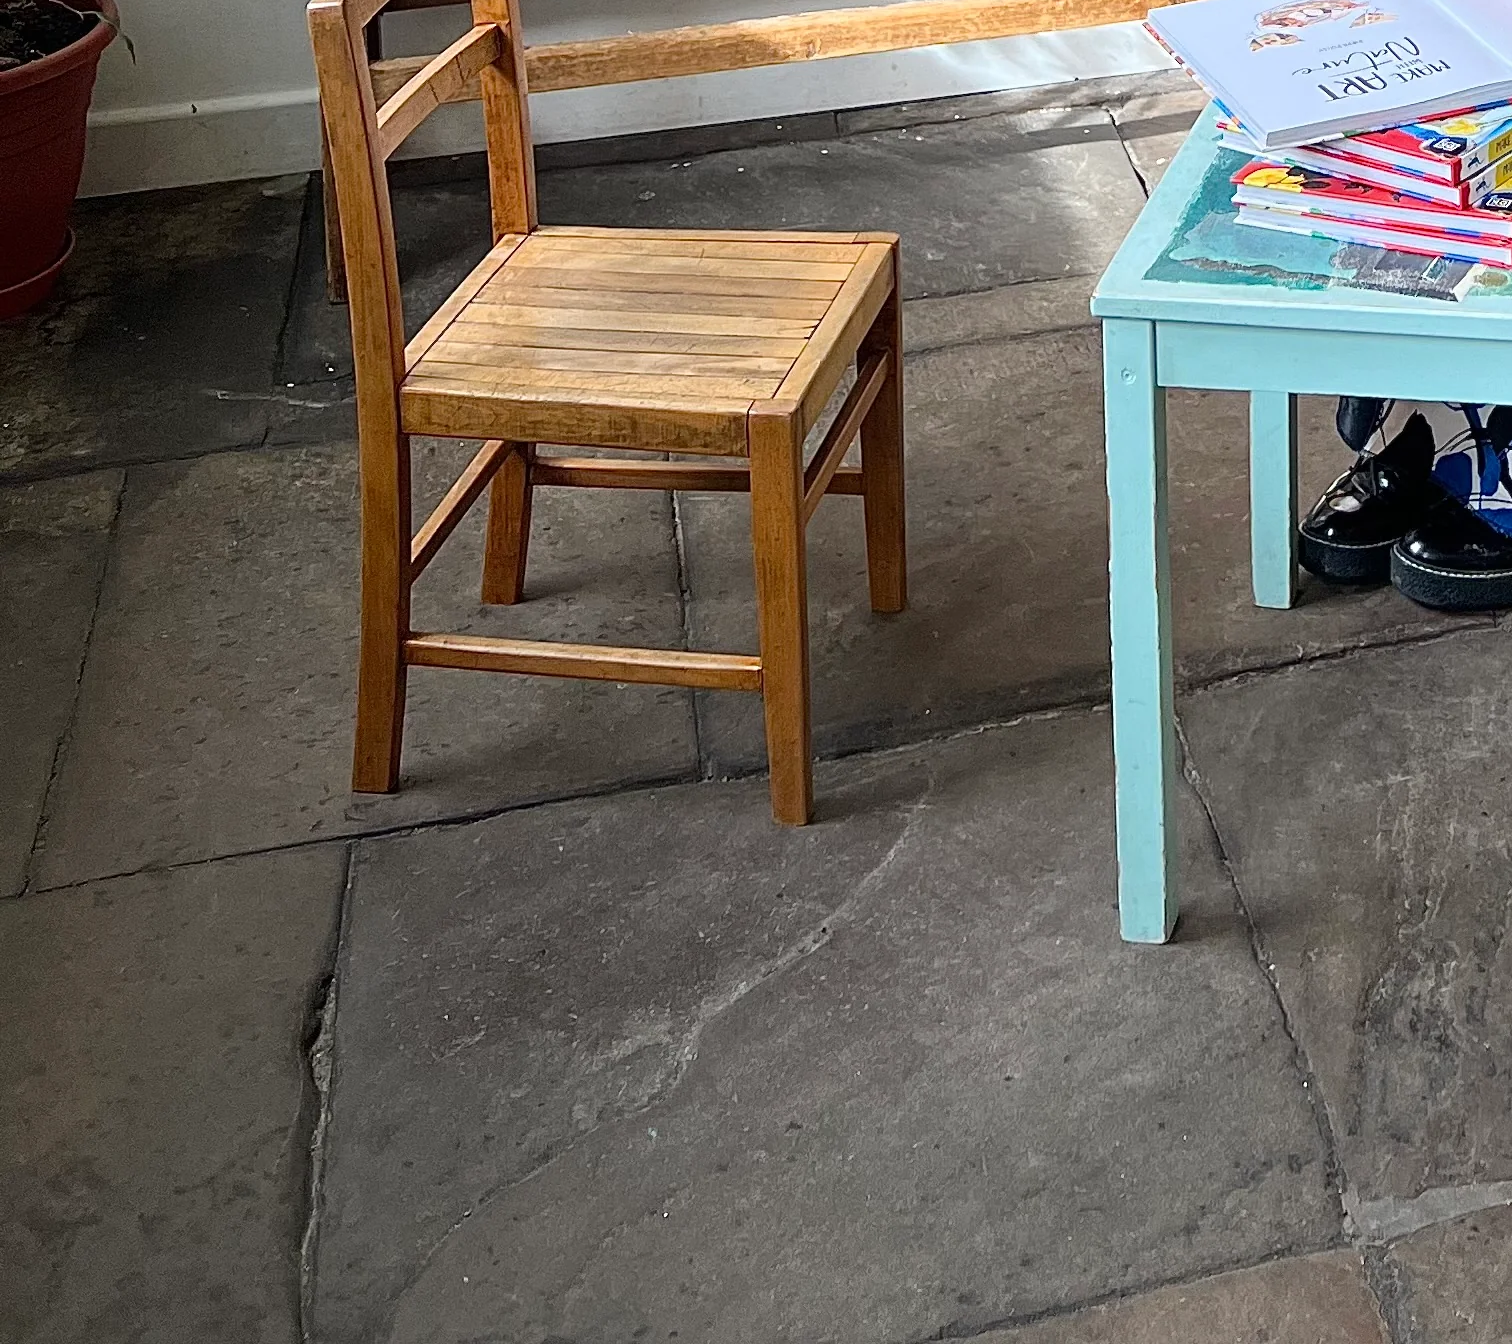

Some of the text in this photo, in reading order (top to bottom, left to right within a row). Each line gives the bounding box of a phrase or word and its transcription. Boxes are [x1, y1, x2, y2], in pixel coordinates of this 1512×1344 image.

[1292, 37, 1420, 76] Nature
[1317, 59, 1451, 102] MAKE ART
